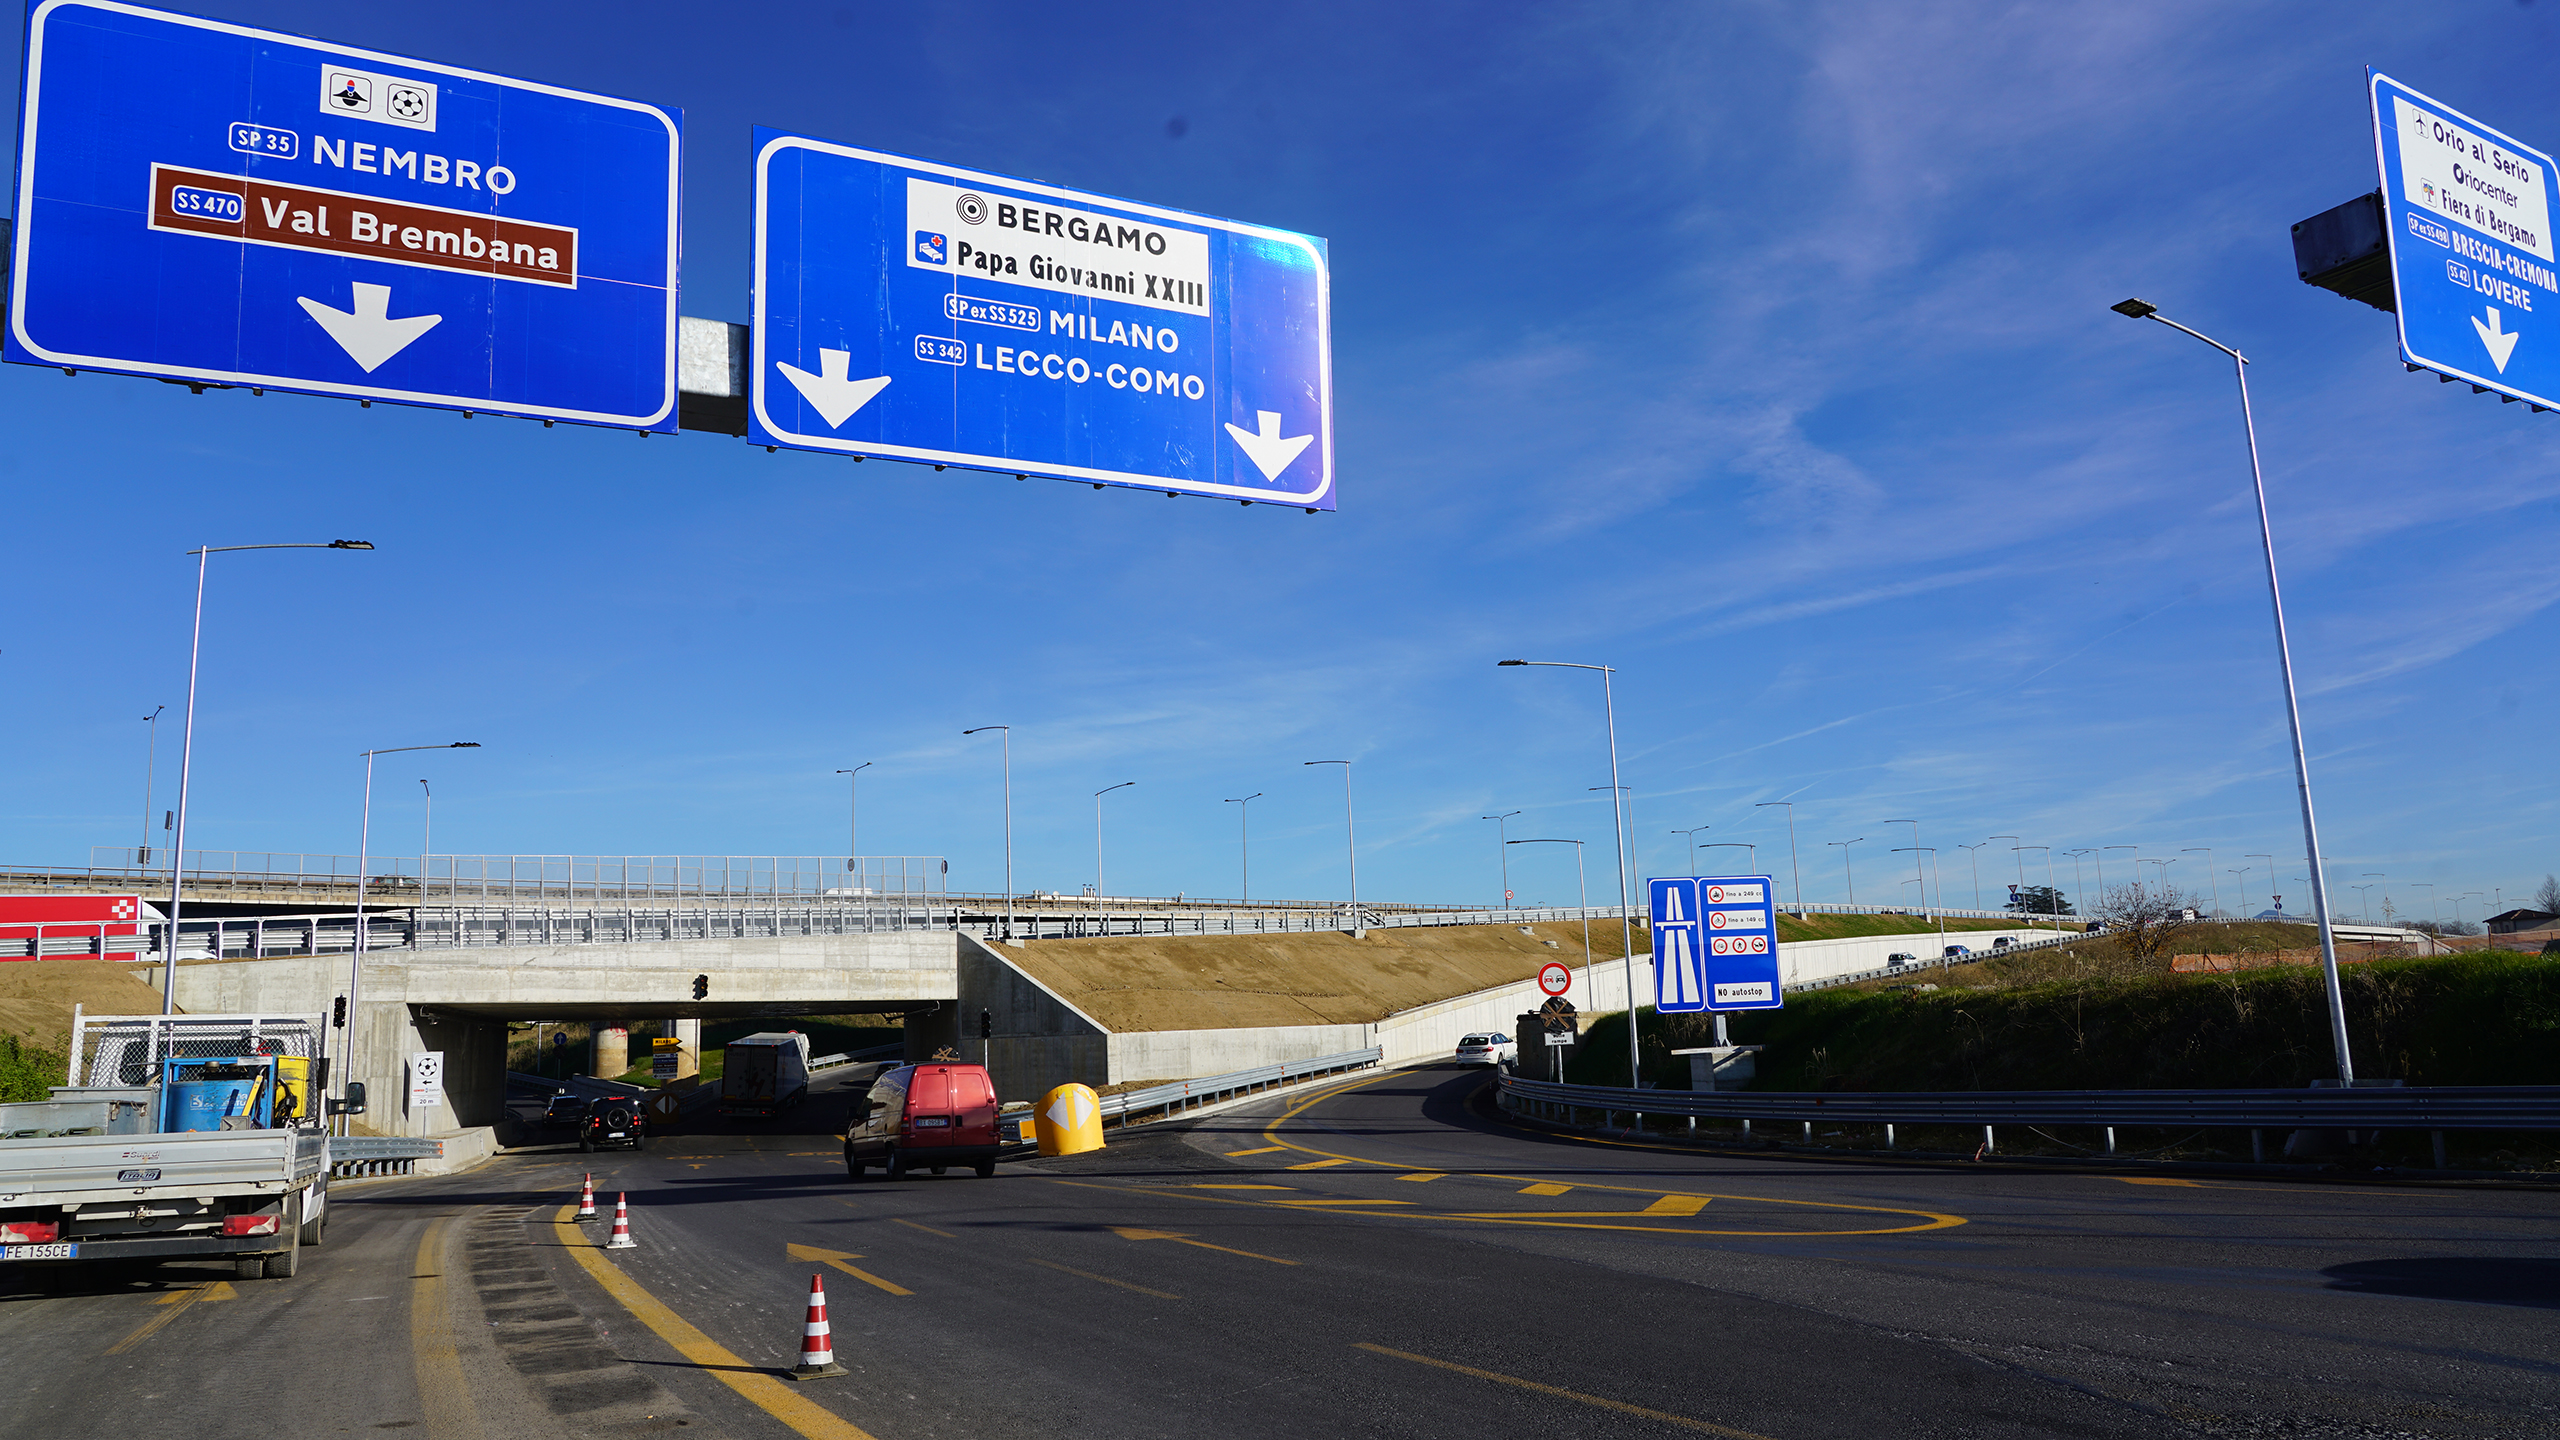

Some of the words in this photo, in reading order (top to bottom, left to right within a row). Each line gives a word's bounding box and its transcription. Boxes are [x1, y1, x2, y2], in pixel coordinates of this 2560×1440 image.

[238, 129, 261, 147] SP
[266, 133, 290, 152] 35
[2433, 121, 2465, 153] Orio
[2472, 143, 2486, 164] al
[2492, 150, 2529, 183] Serio
[313, 135, 516, 195] NEMBRO
[2453, 163, 2518, 209] Oriocenter
[177, 191, 200, 210] SS
[203, 197, 239, 216] 470
[2441, 188, 2471, 220] Fiera
[2475, 204, 2486, 226] di
[2489, 209, 2536, 248] Bergamo
[261, 197, 331, 236] Val
[352, 210, 559, 270] Brembana
[998, 202, 1166, 255] BERGAMO
[958, 241, 1018, 276] Papa
[1030, 254, 1134, 295] Giovanni
[1145, 273, 1203, 307] XXIII
[2449, 265, 2458, 279] SS
[2459, 268, 2468, 282] 42
[2451, 230, 2558, 294] BRESCIA-CREMONA
[2472, 269, 2532, 312] LOVERE
[919, 341, 935, 356] SS
[938, 344, 963, 360] 342
[1050, 309, 1179, 353] MILANO
[976, 343, 1205, 400] LECCO-COMO
[1717, 988, 1728, 996] NO
[1731, 987, 1763, 996] autostop
[6, 1246, 23, 1258] FE
[30, 1244, 69, 1258] 155CE
